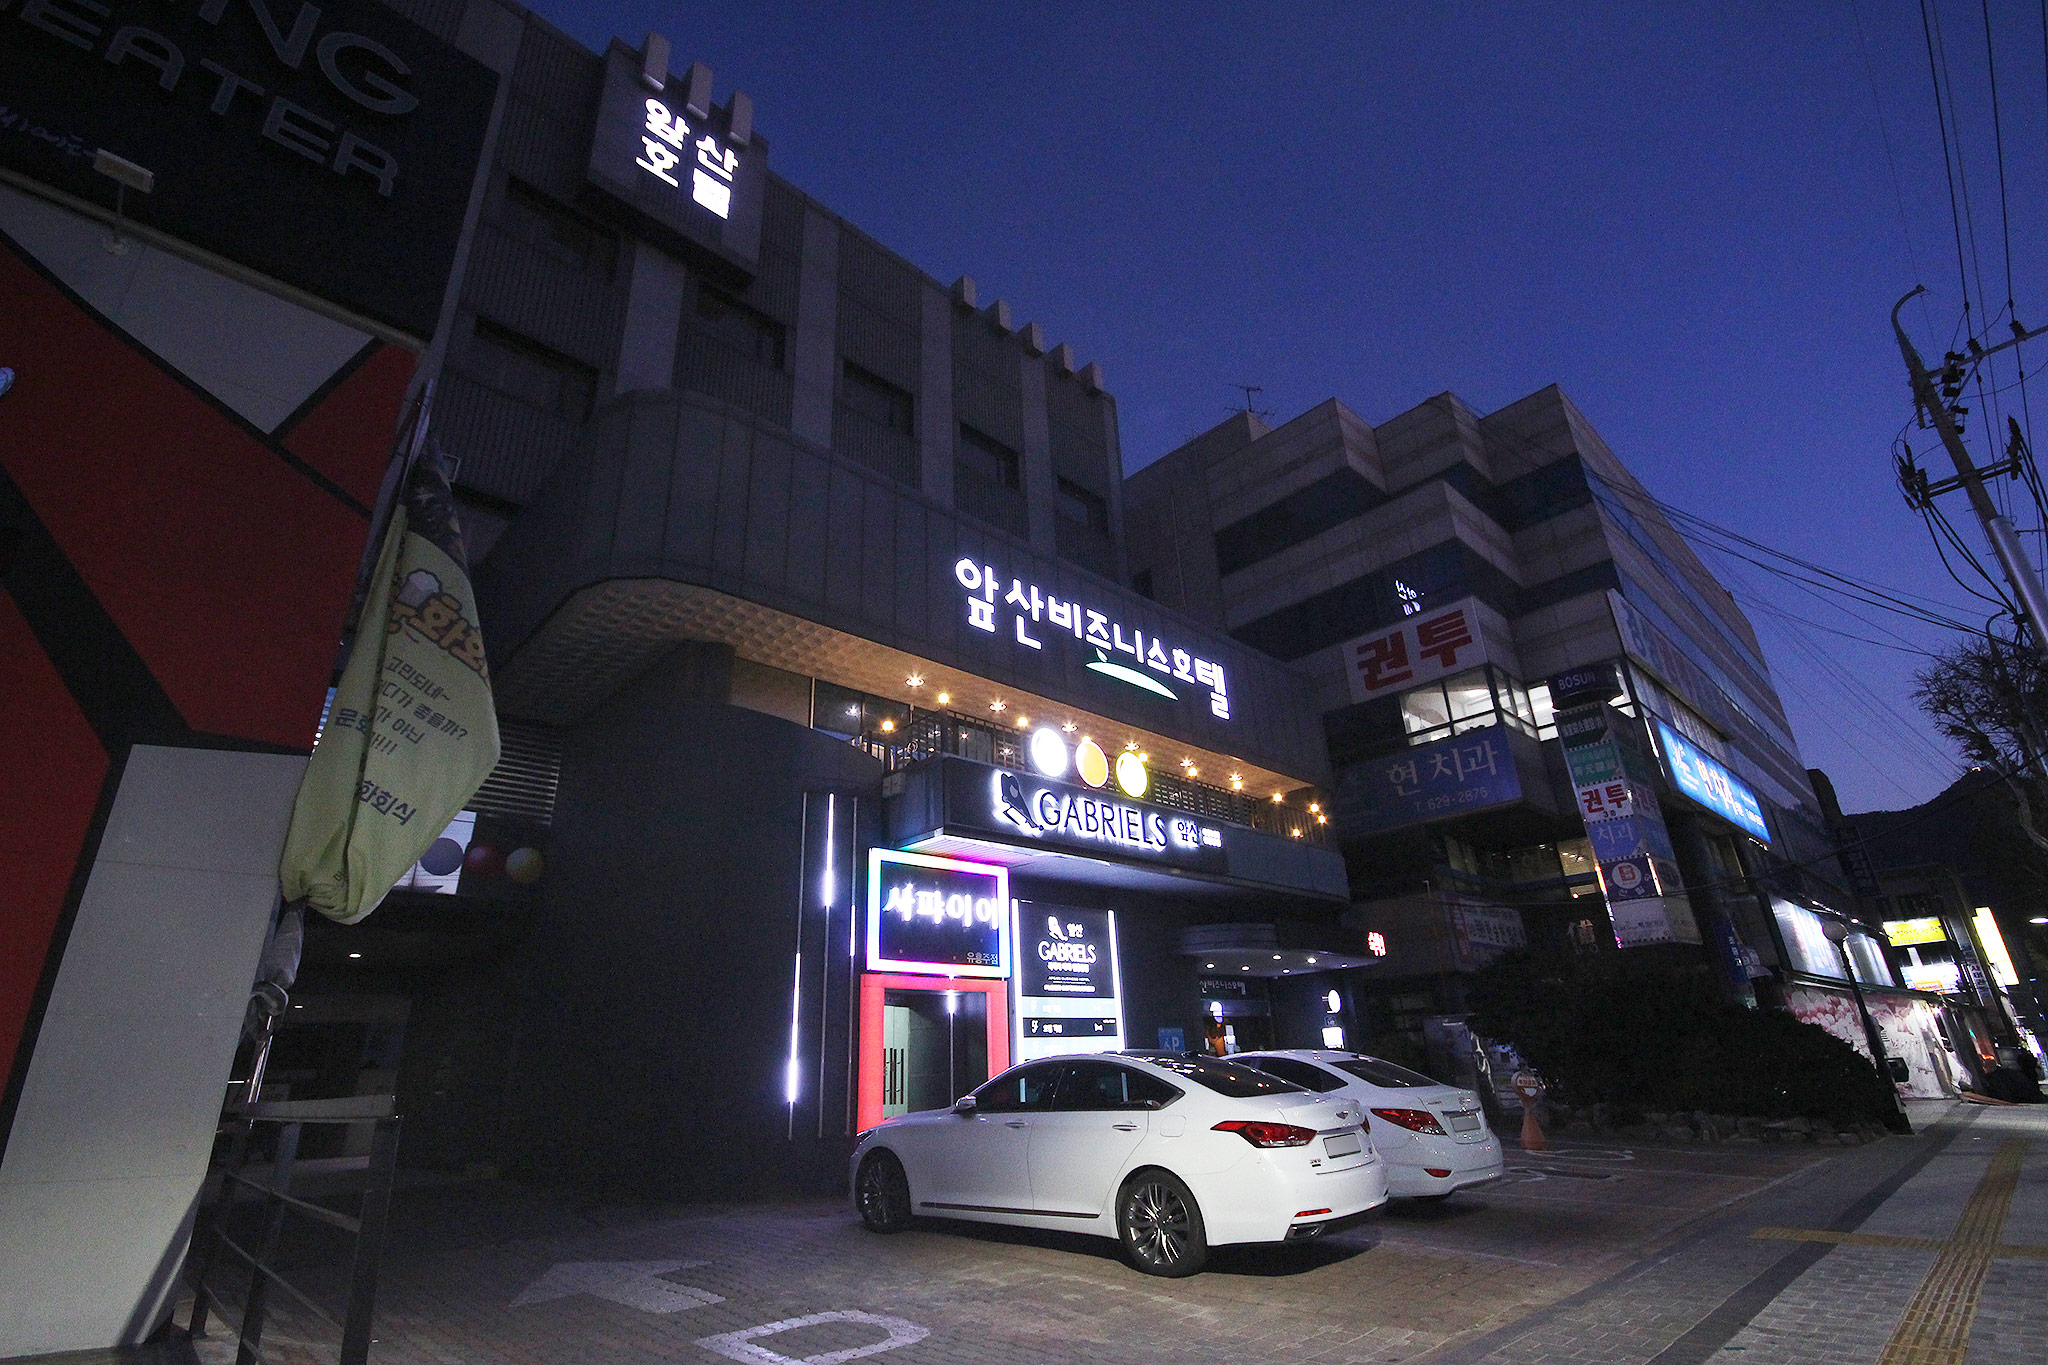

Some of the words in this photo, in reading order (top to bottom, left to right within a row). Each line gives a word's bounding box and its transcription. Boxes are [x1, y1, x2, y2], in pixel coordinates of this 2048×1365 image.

[0, 0, 398, 198] EATER
[1357, 609, 1472, 691] 권투
[1430, 739, 1498, 782] 치과
[1039, 791, 1168, 848] GABRIELS
[1581, 783, 1628, 813] 권투
